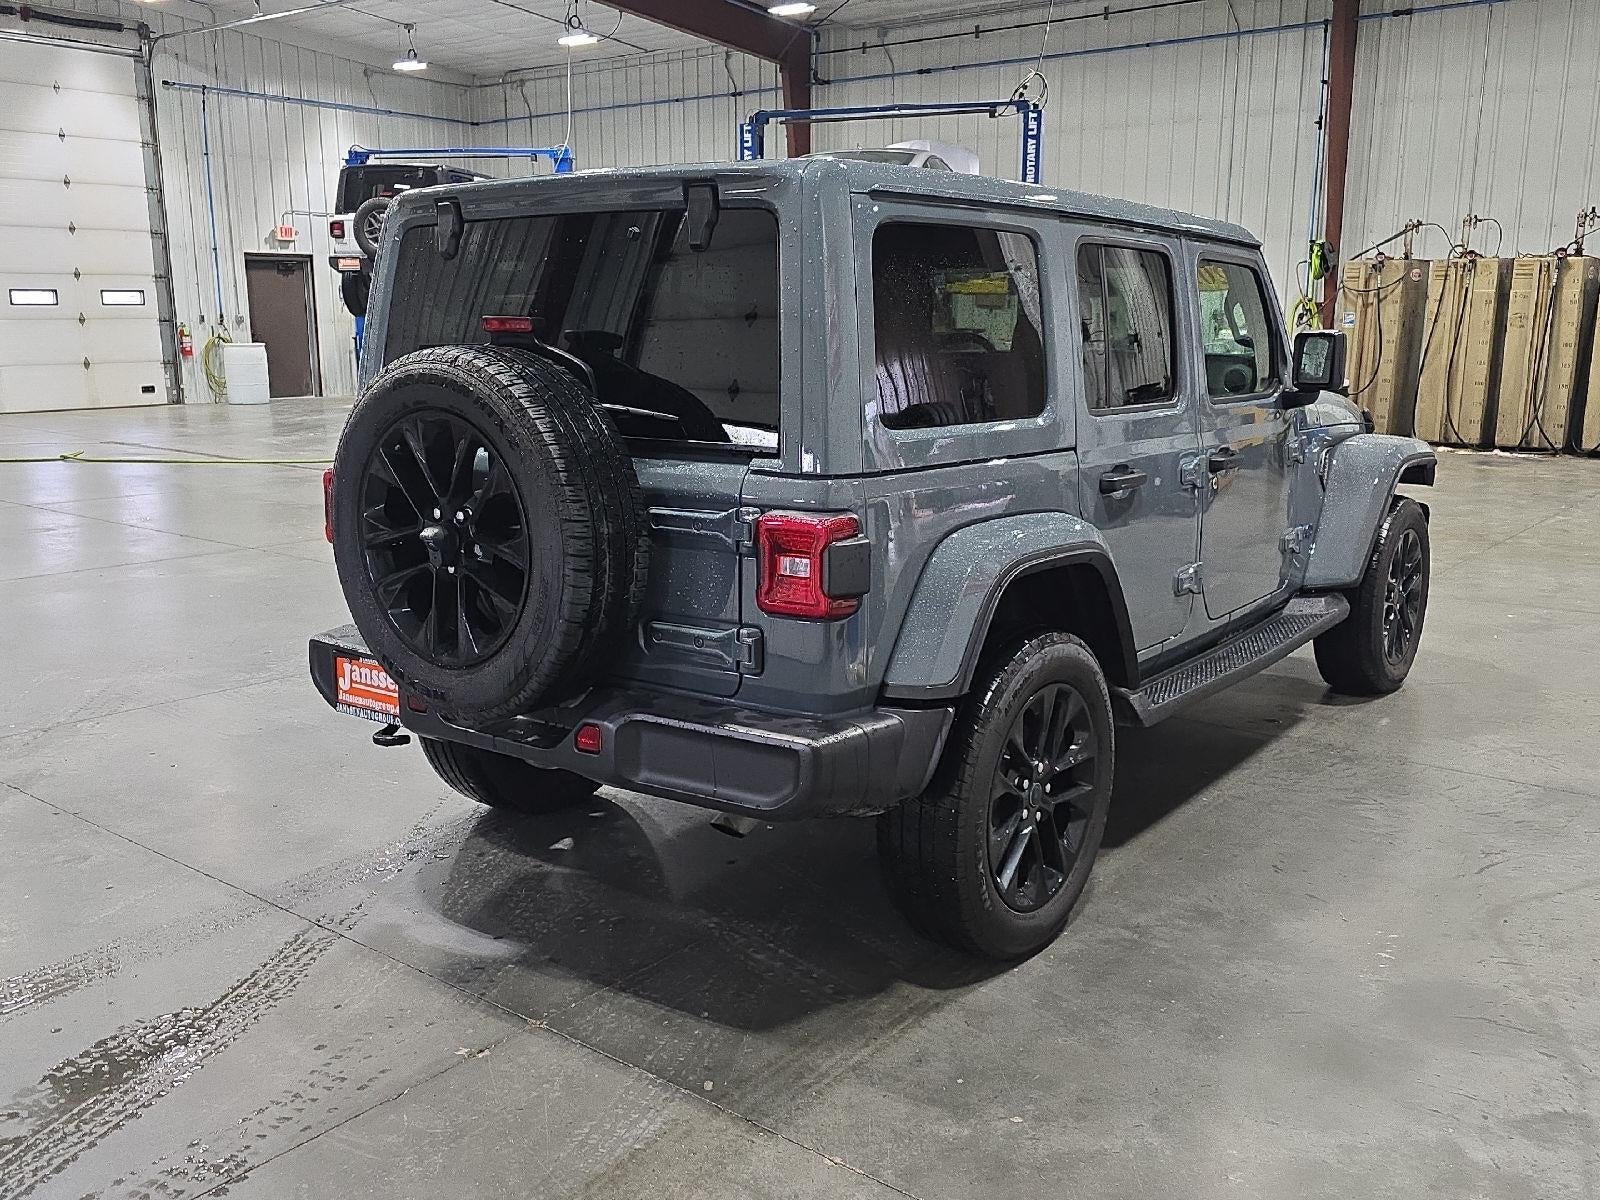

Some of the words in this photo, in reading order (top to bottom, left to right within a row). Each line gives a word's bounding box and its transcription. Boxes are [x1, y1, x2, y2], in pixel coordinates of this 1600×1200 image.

[1028, 111, 1038, 135] LIFT
[743, 124, 752, 148] LIFT
[1026, 138, 1037, 183] ROTARY
[280, 226, 293, 238] EXIT
